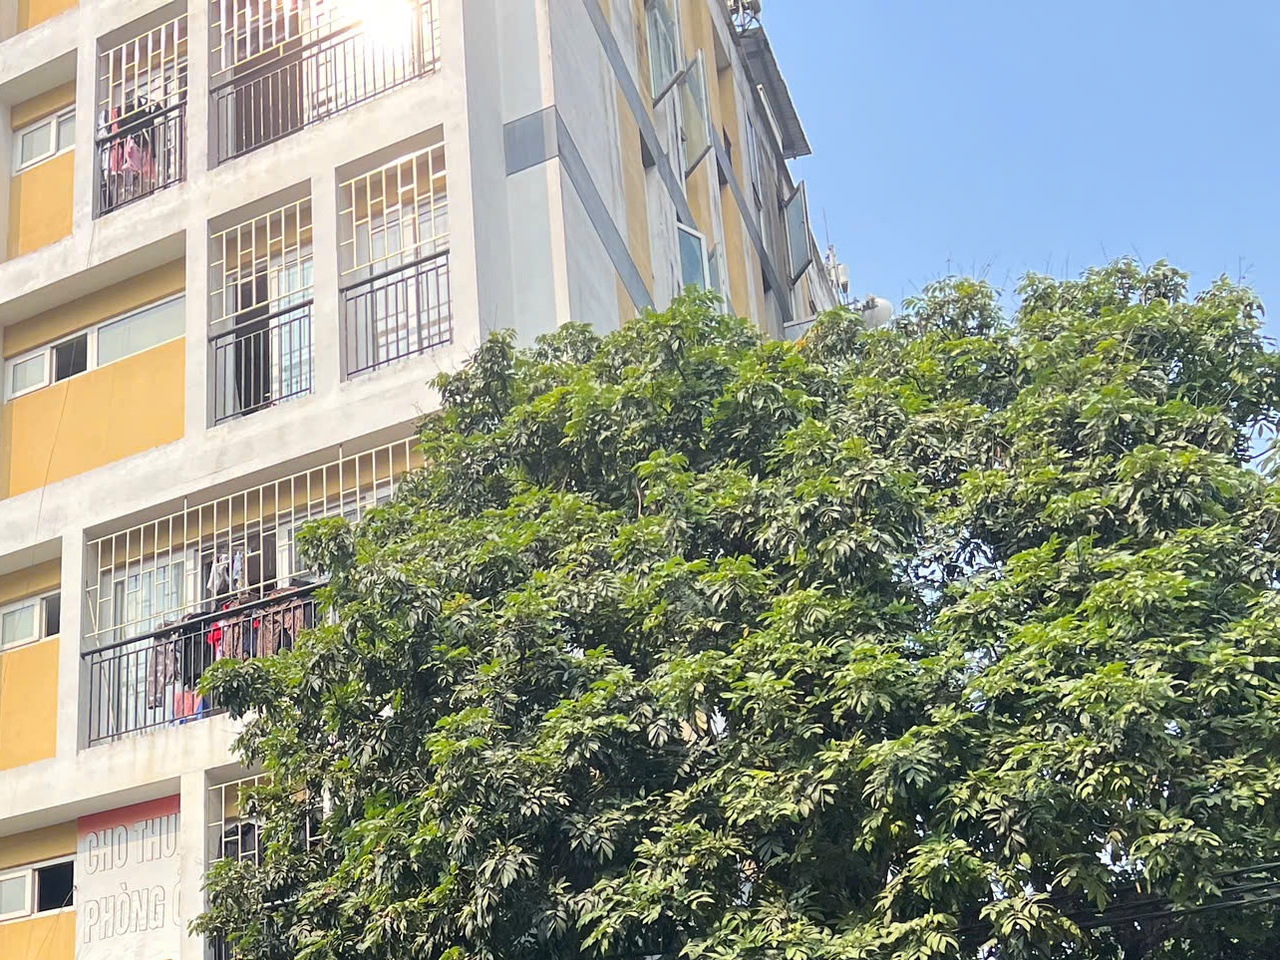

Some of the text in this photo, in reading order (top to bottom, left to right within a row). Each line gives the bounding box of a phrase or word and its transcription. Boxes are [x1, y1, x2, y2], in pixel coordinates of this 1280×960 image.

[84, 812, 181, 875] CHO THU
[83, 882, 166, 944] PHÒNG
